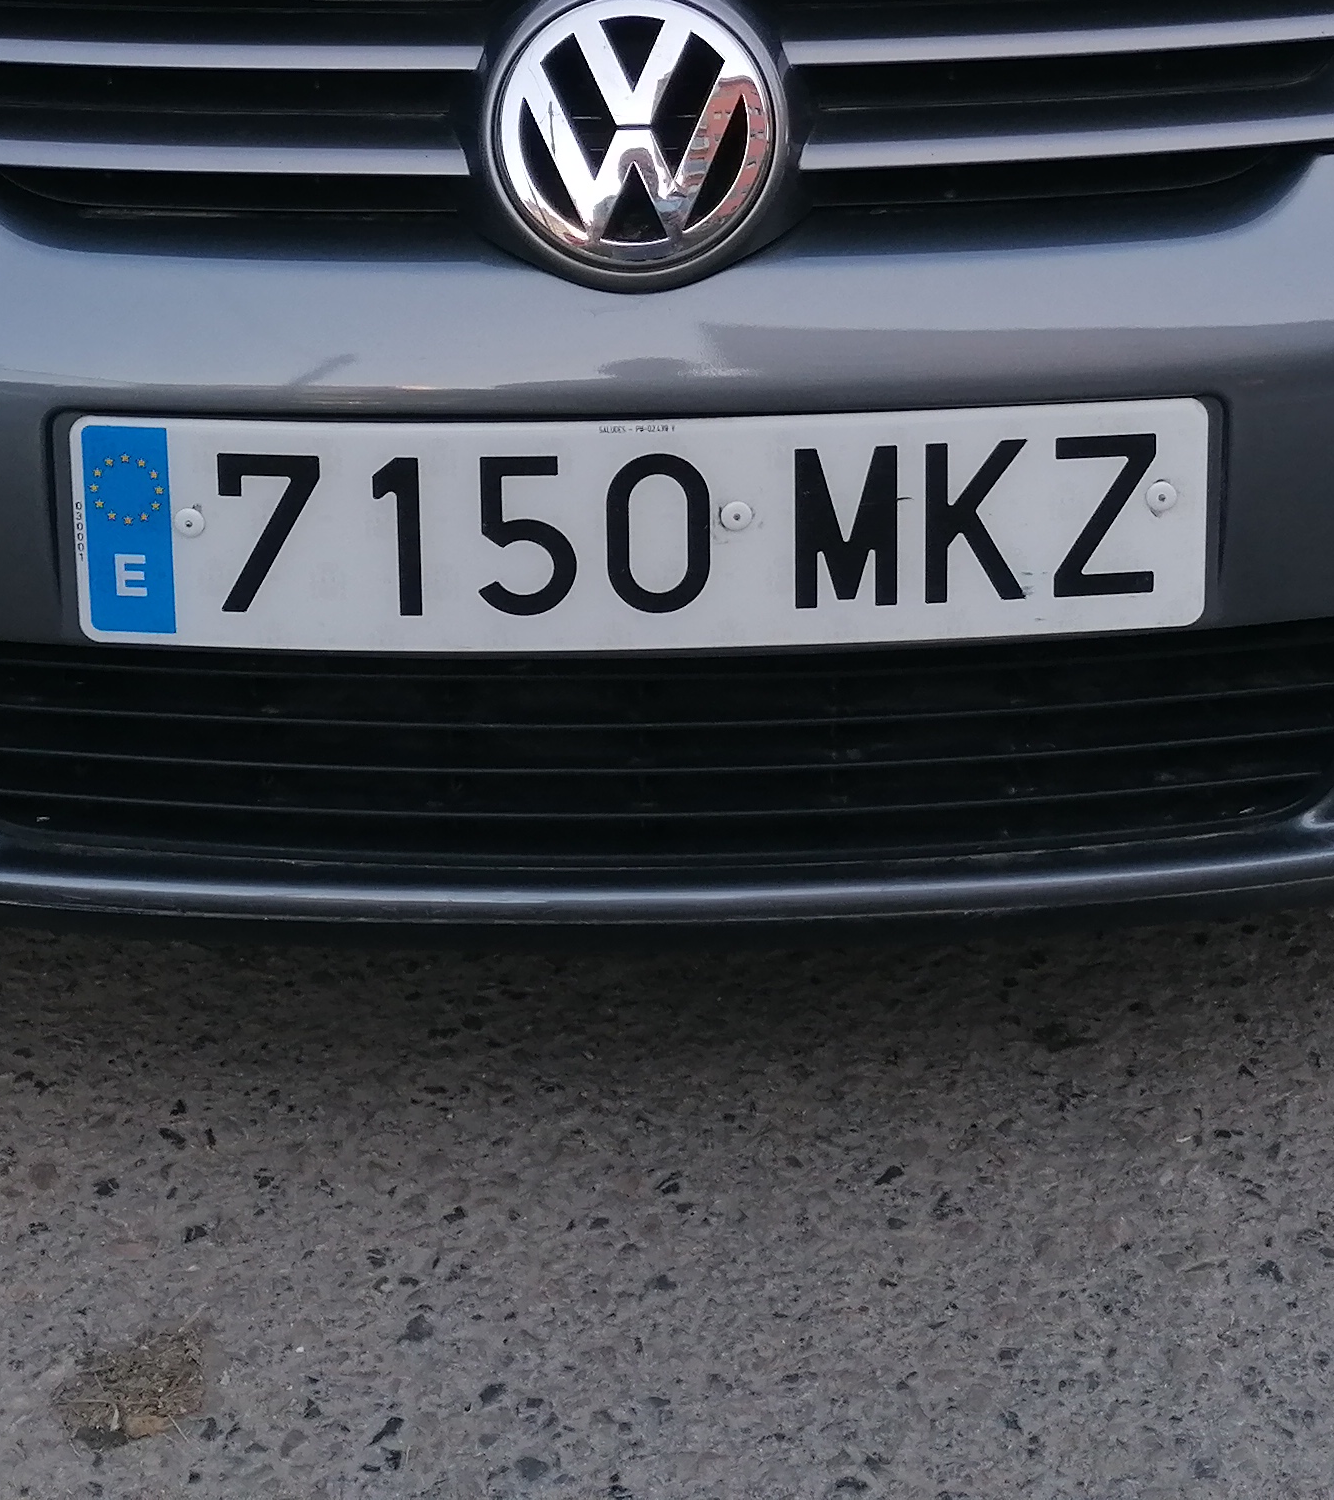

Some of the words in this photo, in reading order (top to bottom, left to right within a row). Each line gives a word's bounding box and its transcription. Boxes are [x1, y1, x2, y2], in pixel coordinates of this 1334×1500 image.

[114, 553, 148, 597] E
[217, 452, 711, 616] 7150
[794, 434, 1158, 610] MKZ
